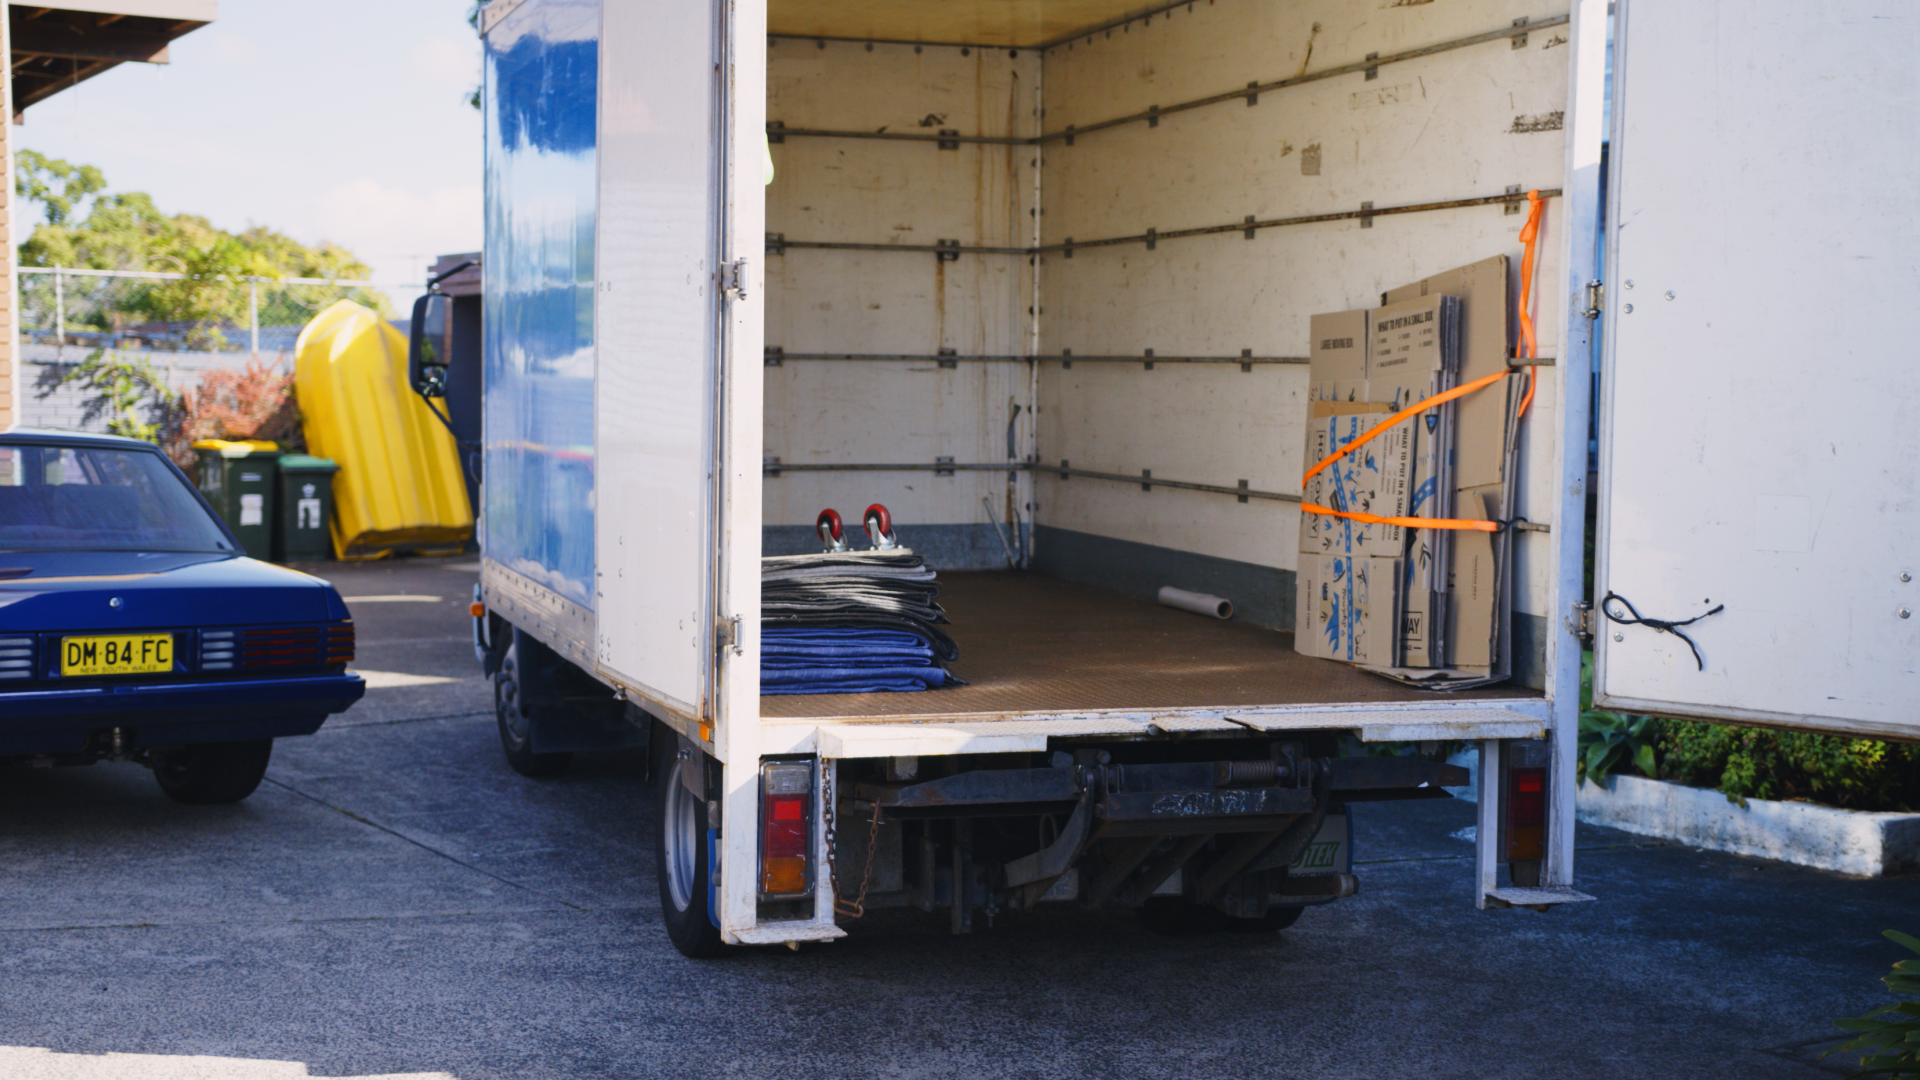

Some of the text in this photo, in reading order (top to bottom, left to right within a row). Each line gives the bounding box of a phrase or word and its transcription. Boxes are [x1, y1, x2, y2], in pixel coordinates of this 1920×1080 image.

[1378, 321, 1388, 332] WHAT
[1390, 320, 1394, 330] TO
[1403, 316, 1408, 327] IN
[1412, 313, 1424, 325] SMALL
[1424, 311, 1433, 322] BOX
[1320, 339, 1332, 350] LARGE
[1332, 338, 1345, 349] MOVING
[1400, 451, 1406, 460] TO
[1398, 480, 1404, 488] IN
[68, 640, 168, 666] DM 84 FC
